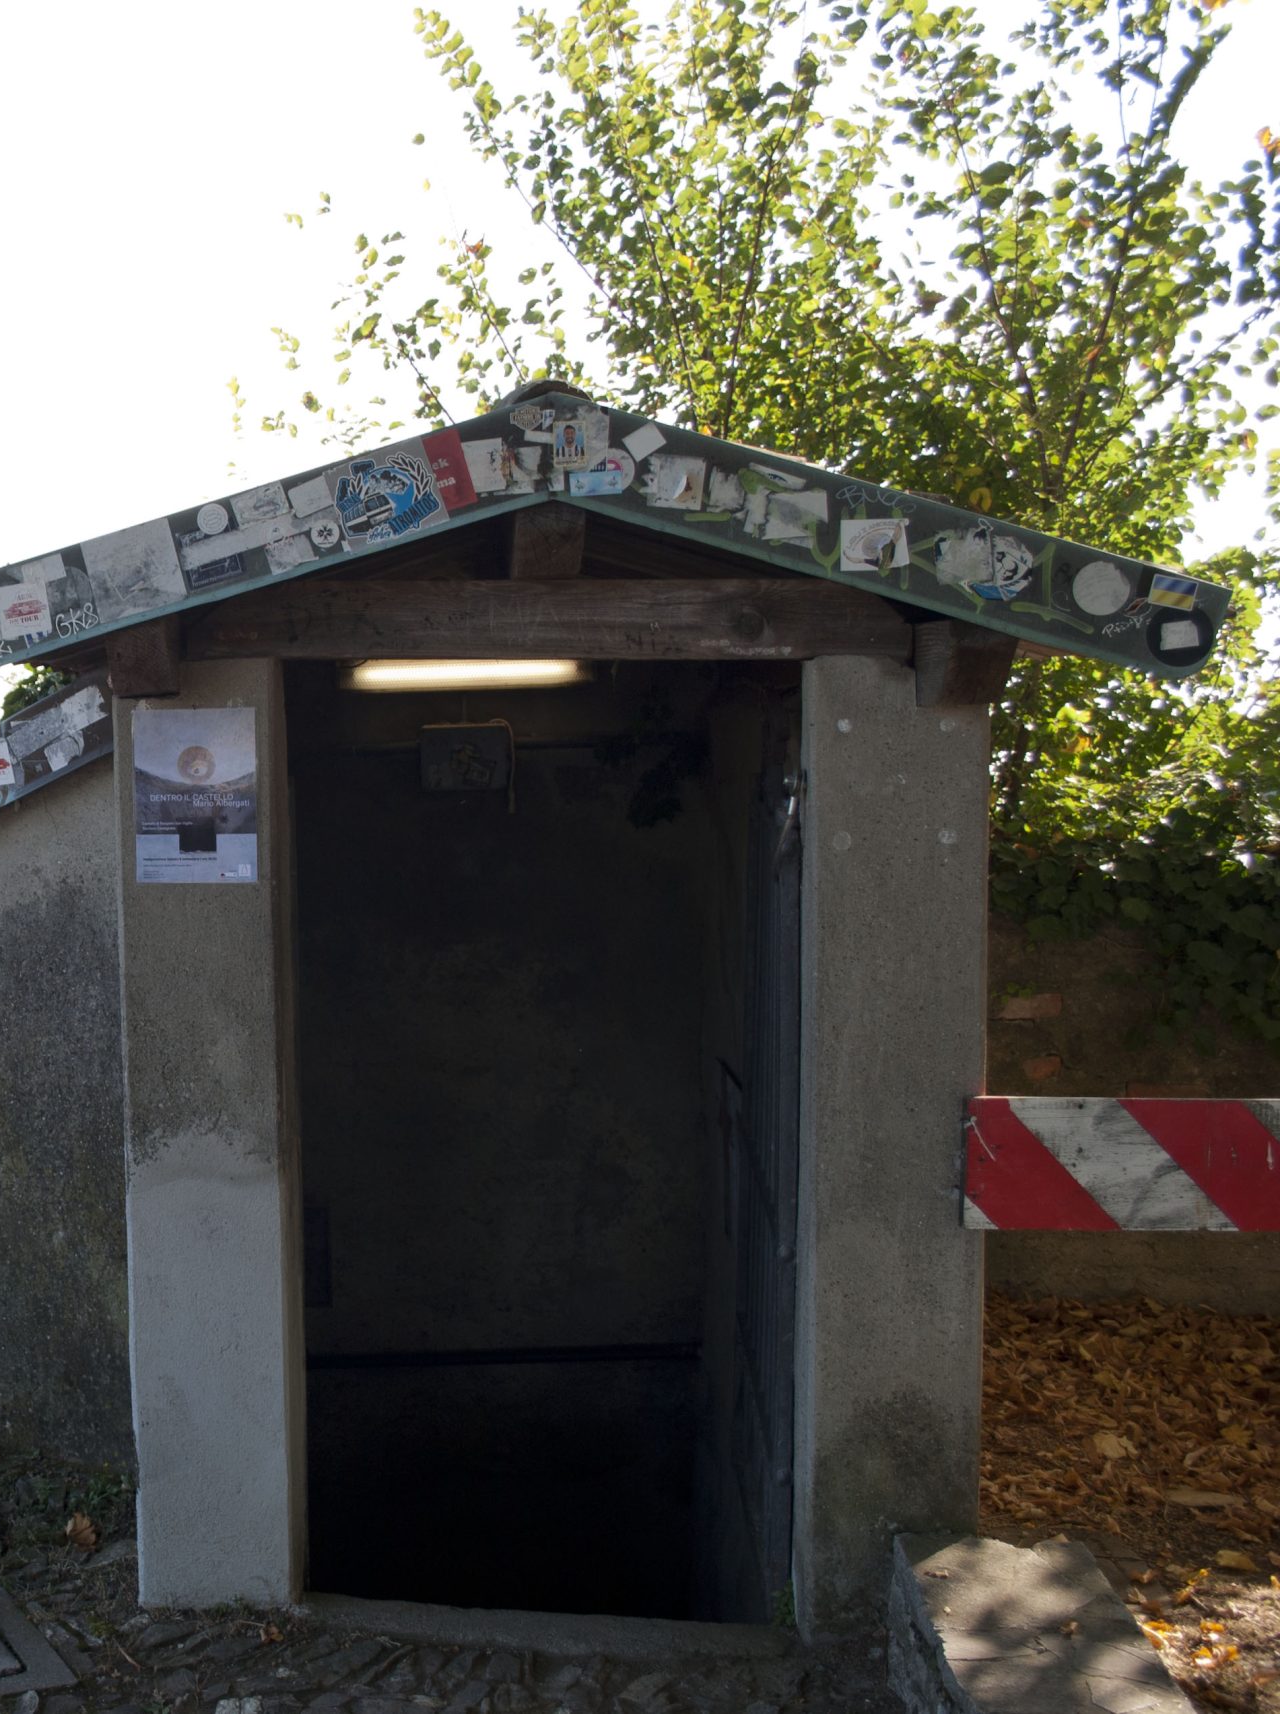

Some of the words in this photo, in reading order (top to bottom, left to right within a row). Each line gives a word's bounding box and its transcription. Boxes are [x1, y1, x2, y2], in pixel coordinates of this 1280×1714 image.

[150, 794, 183, 802] DENTRO
[192, 793, 234, 801] CASTELLO
[193, 800, 214, 808] Mario
[216, 799, 250, 809] Albergati
